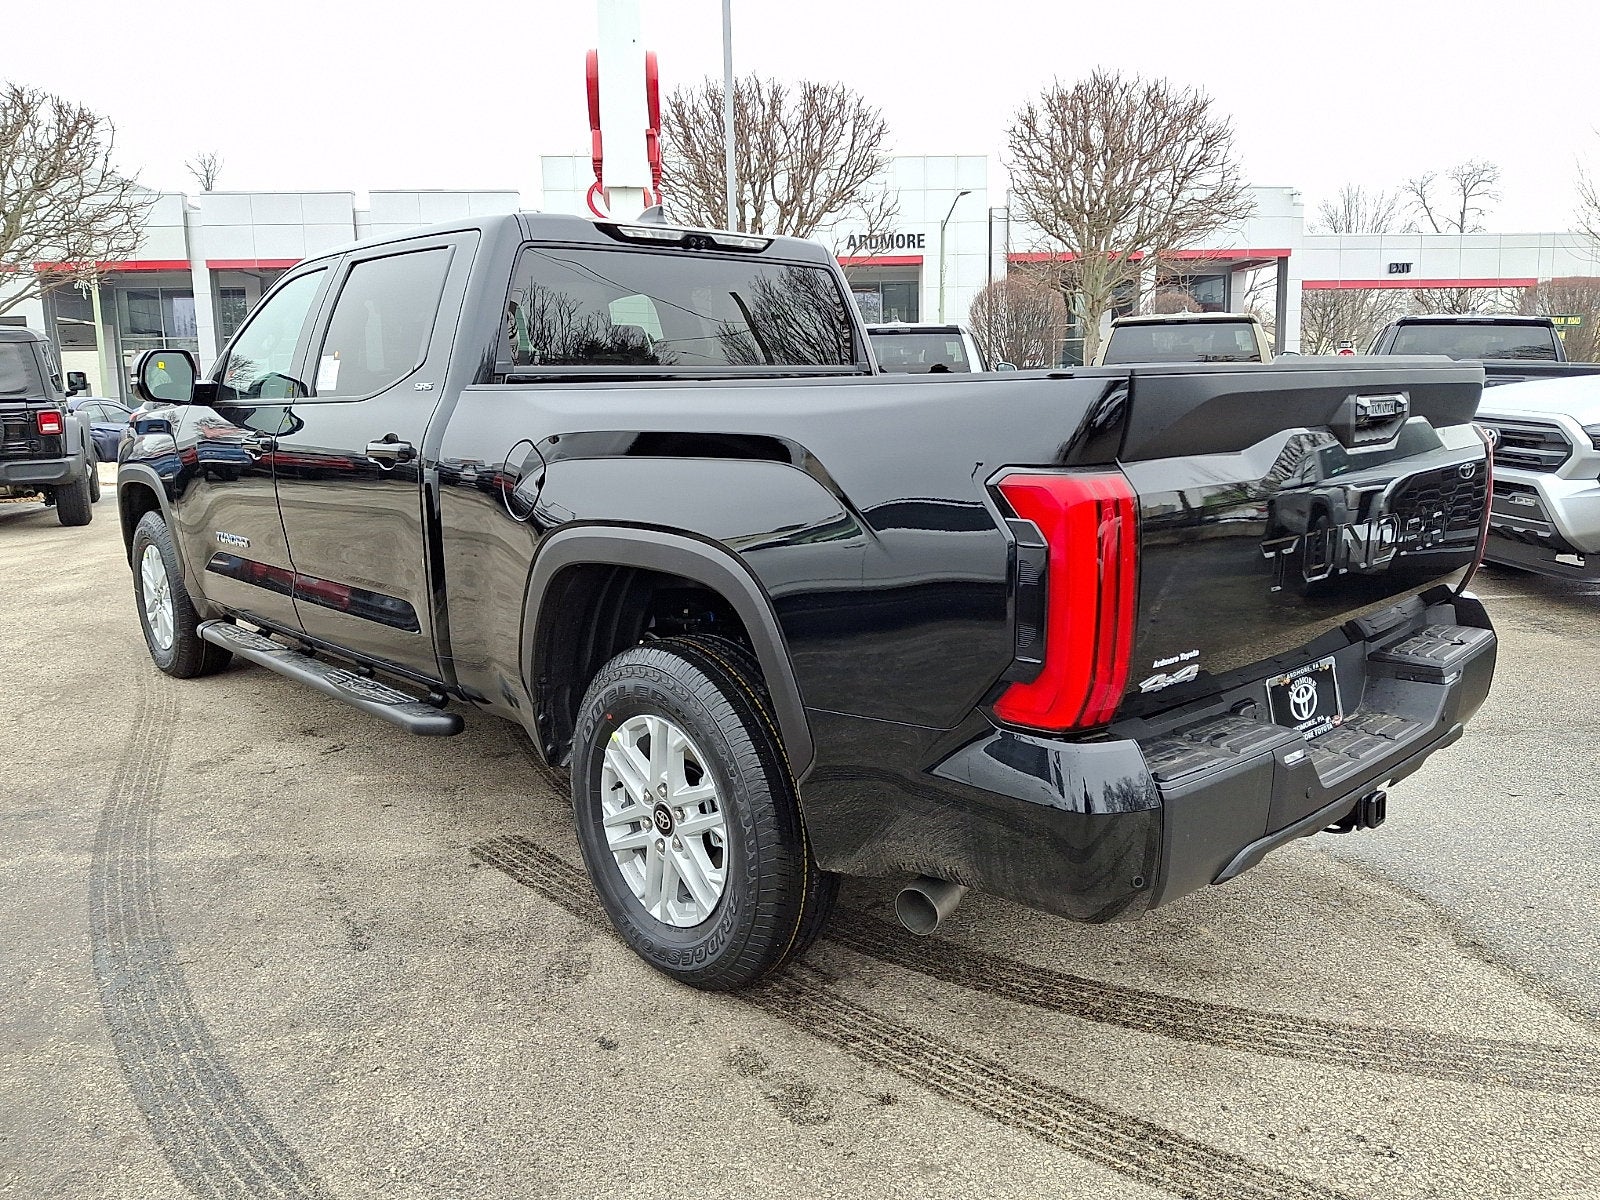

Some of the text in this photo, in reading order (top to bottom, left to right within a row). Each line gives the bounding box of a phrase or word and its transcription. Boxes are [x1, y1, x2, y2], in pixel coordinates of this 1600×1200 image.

[846, 233, 926, 250] ARDMORE
[1389, 262, 1413, 274] EXIT
[414, 382, 434, 392] SR5
[1371, 402, 1396, 415] TOYOTA
[215, 530, 252, 548] TUNDRA
[1259, 503, 1447, 592] TUNDRA
[1288, 676, 1318, 700] ARDMORE
